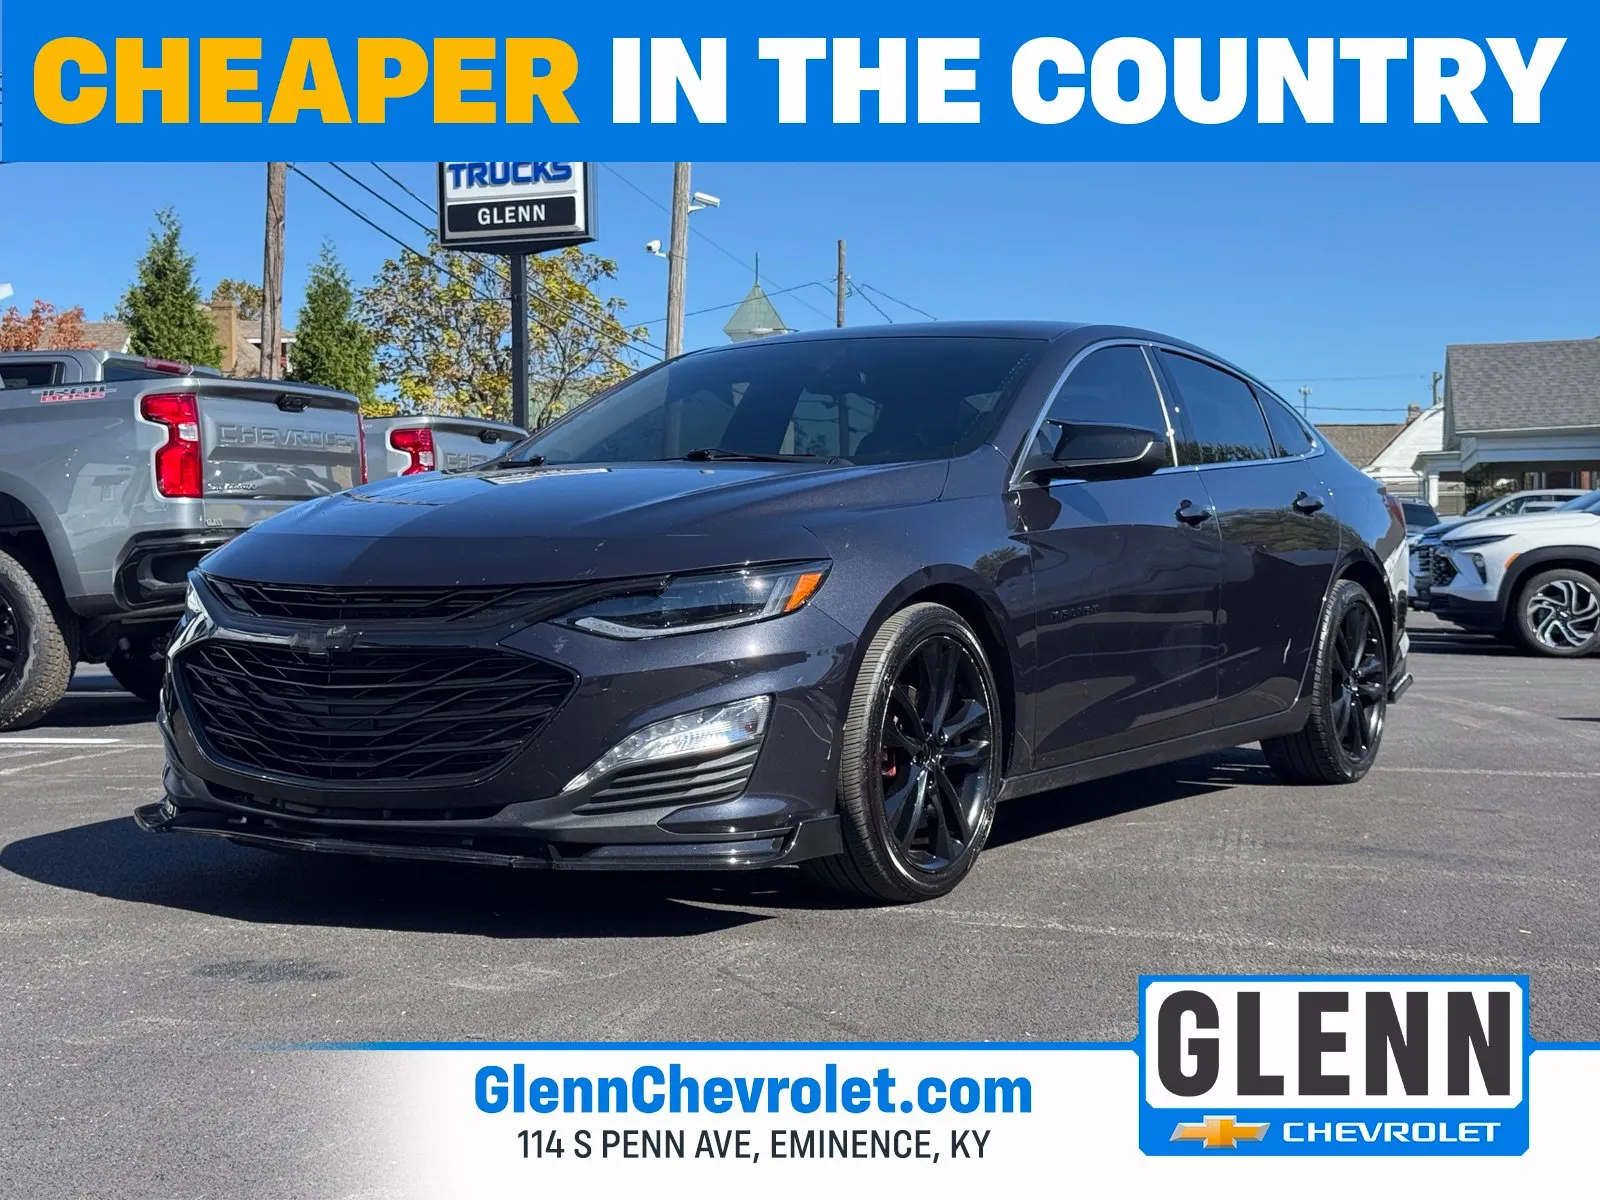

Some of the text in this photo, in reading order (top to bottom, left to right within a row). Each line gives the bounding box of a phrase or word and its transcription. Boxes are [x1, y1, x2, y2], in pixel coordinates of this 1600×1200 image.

[447, 162, 572, 188] TRUCKS
[478, 204, 546, 225] GLENN
[219, 424, 357, 449] CHEVROLET
